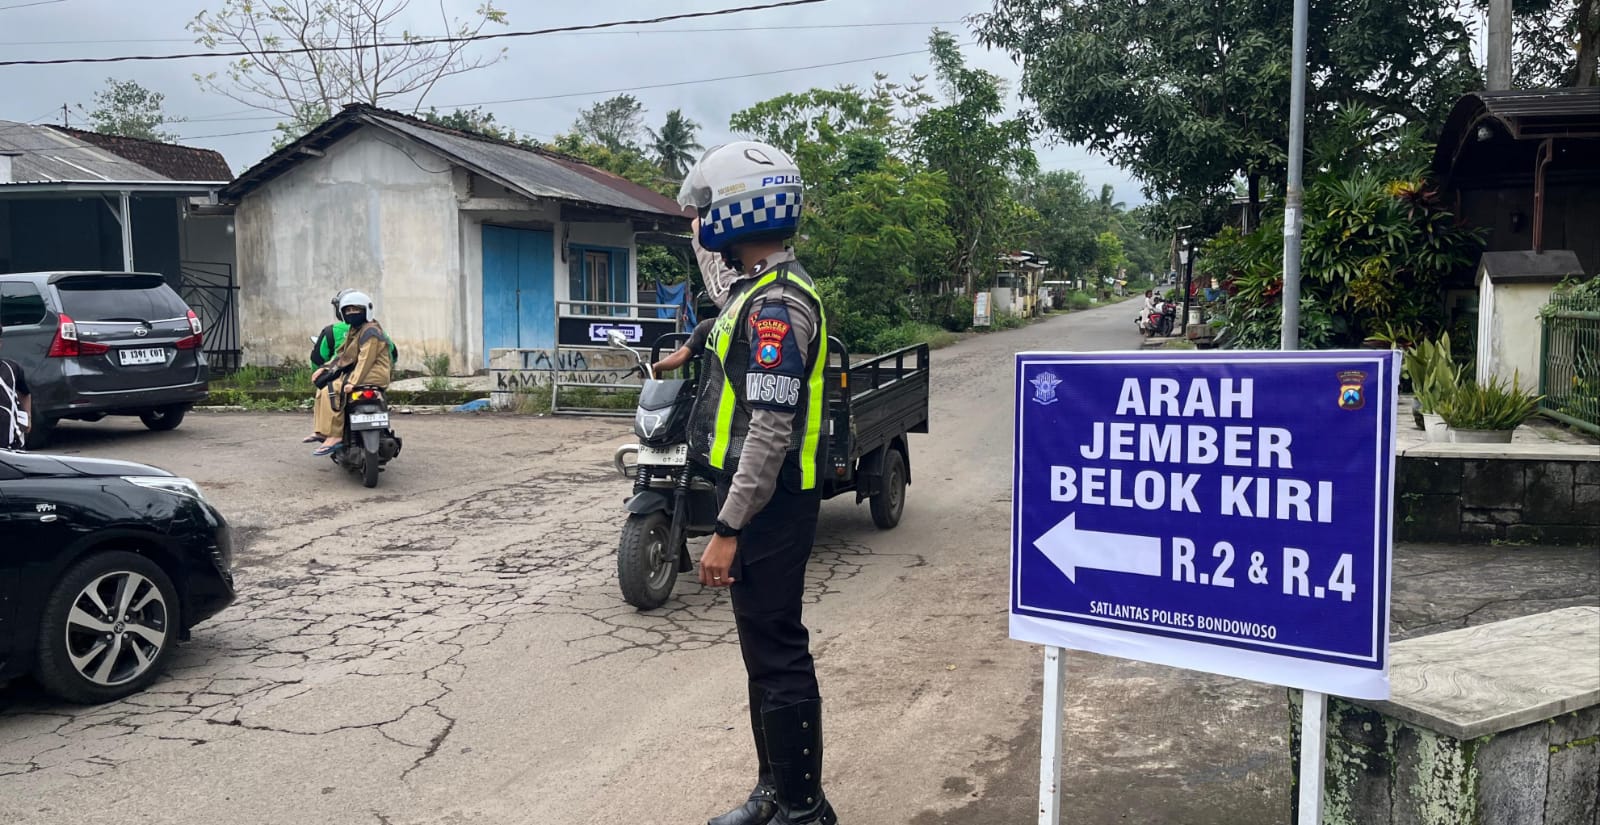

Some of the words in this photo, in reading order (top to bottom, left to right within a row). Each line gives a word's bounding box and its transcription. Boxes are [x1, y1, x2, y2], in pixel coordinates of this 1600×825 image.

[1115, 377, 1254, 419] ARAH
[1079, 421, 1293, 469] JEMBER
[1050, 465, 1202, 514] BELOK
[1220, 475, 1333, 523] KIRI
[1171, 536, 1236, 588] R.2
[1247, 551, 1269, 585] &
[1282, 547, 1356, 602] R.4
[1089, 600, 1149, 621] SATLANTAS
[1152, 609, 1195, 628] POLRES
[1197, 615, 1277, 640] BONDOWOSO
